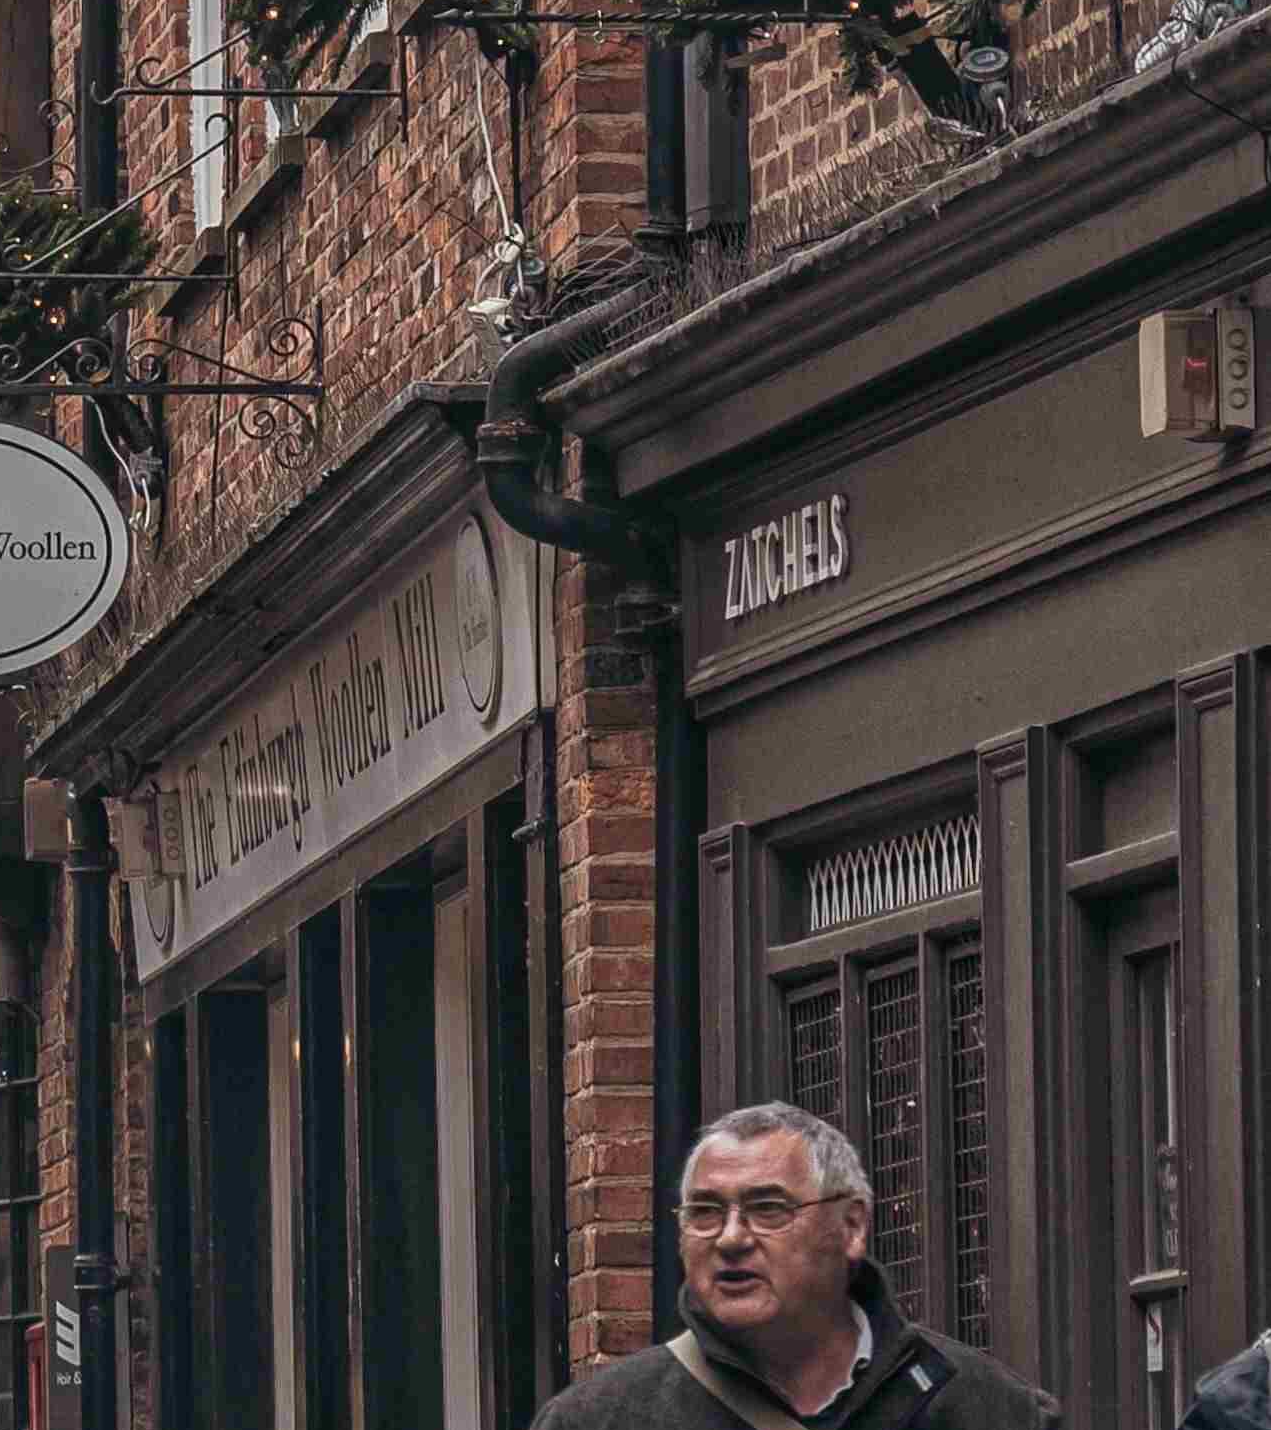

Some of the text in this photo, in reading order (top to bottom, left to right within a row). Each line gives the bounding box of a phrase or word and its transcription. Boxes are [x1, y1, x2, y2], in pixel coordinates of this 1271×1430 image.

[724, 493, 847, 620] ZATCHELS
[185, 763, 219, 890] The
[220, 682, 312, 853] Edinburgh
[309, 631, 392, 799] Woollen
[393, 572, 446, 740] Mill
